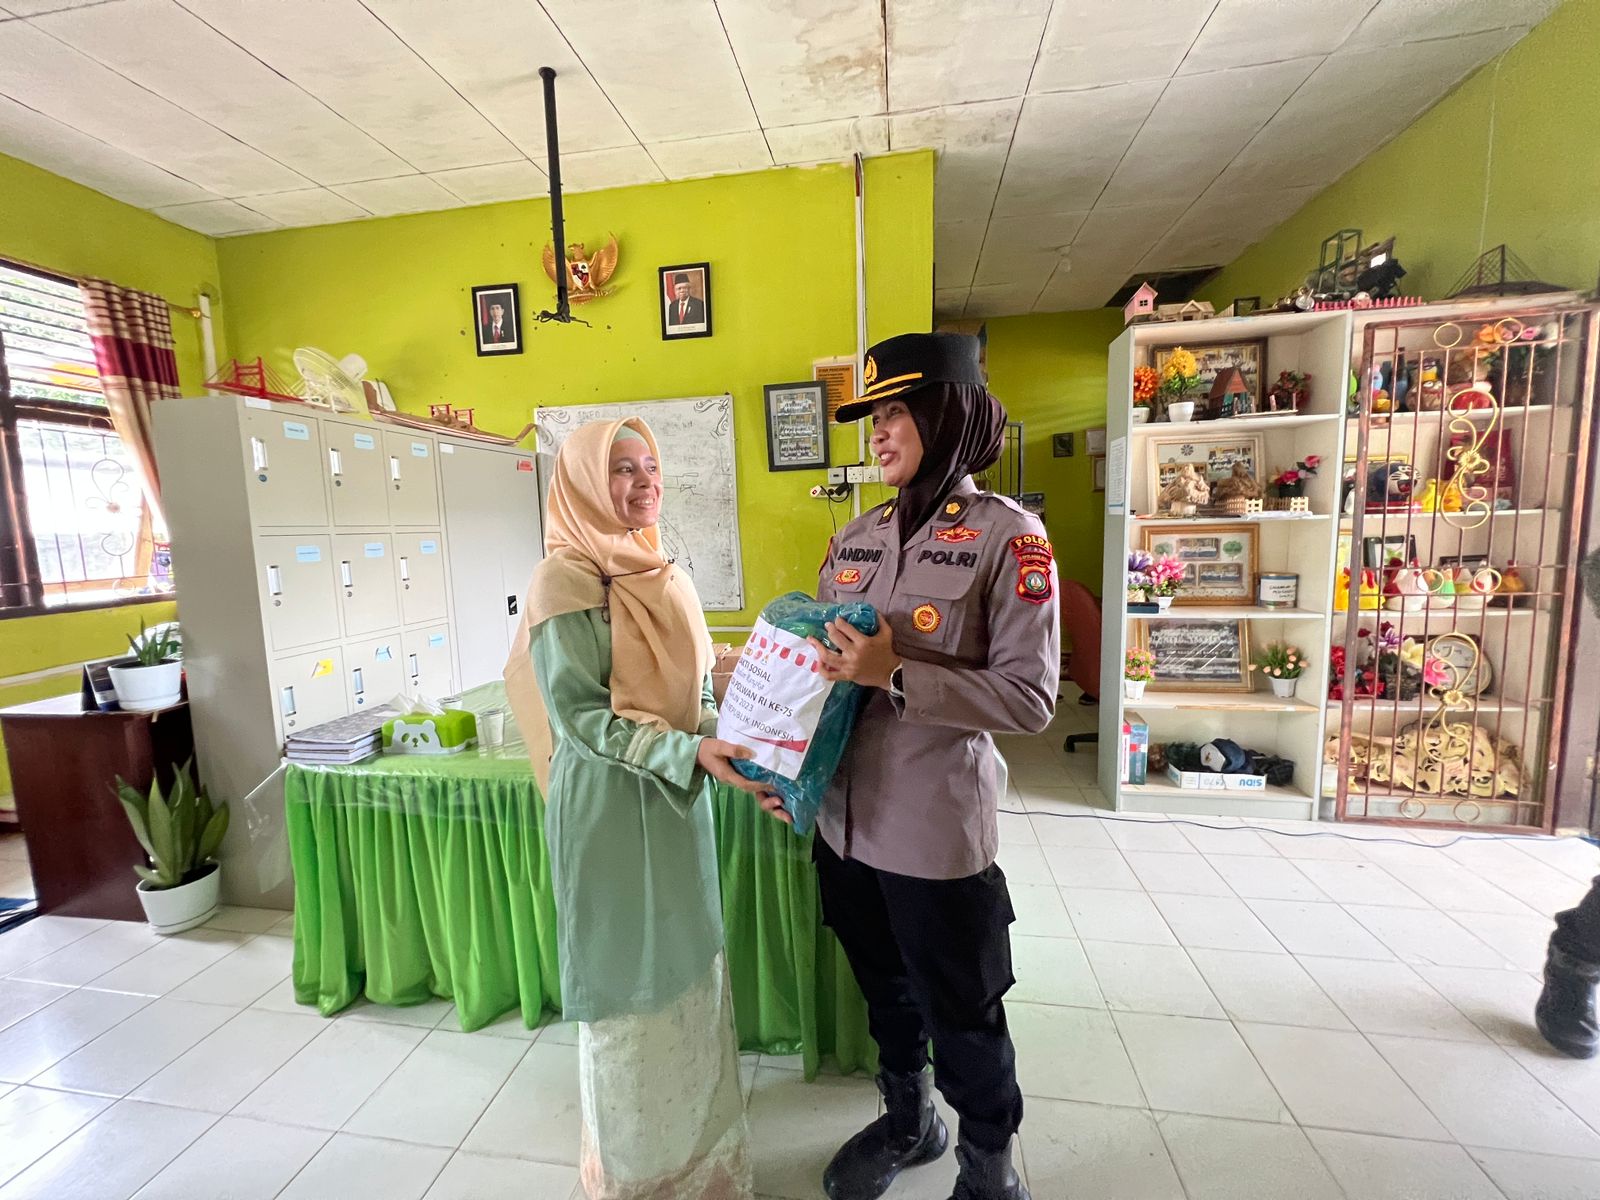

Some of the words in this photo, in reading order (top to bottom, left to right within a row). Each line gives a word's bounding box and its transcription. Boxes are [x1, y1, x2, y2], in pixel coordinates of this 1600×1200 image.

[1015, 535, 1050, 551] POLDA
[837, 548, 883, 562] ANDINI
[917, 549, 977, 568] POLRI
[748, 663, 771, 682] SOSIAL
[735, 680, 758, 701] POLWAN
[758, 696, 767, 707] RI
[768, 701, 793, 717] KE-75
[739, 698, 754, 712] 2023
[751, 719, 794, 743] INDONESIA
